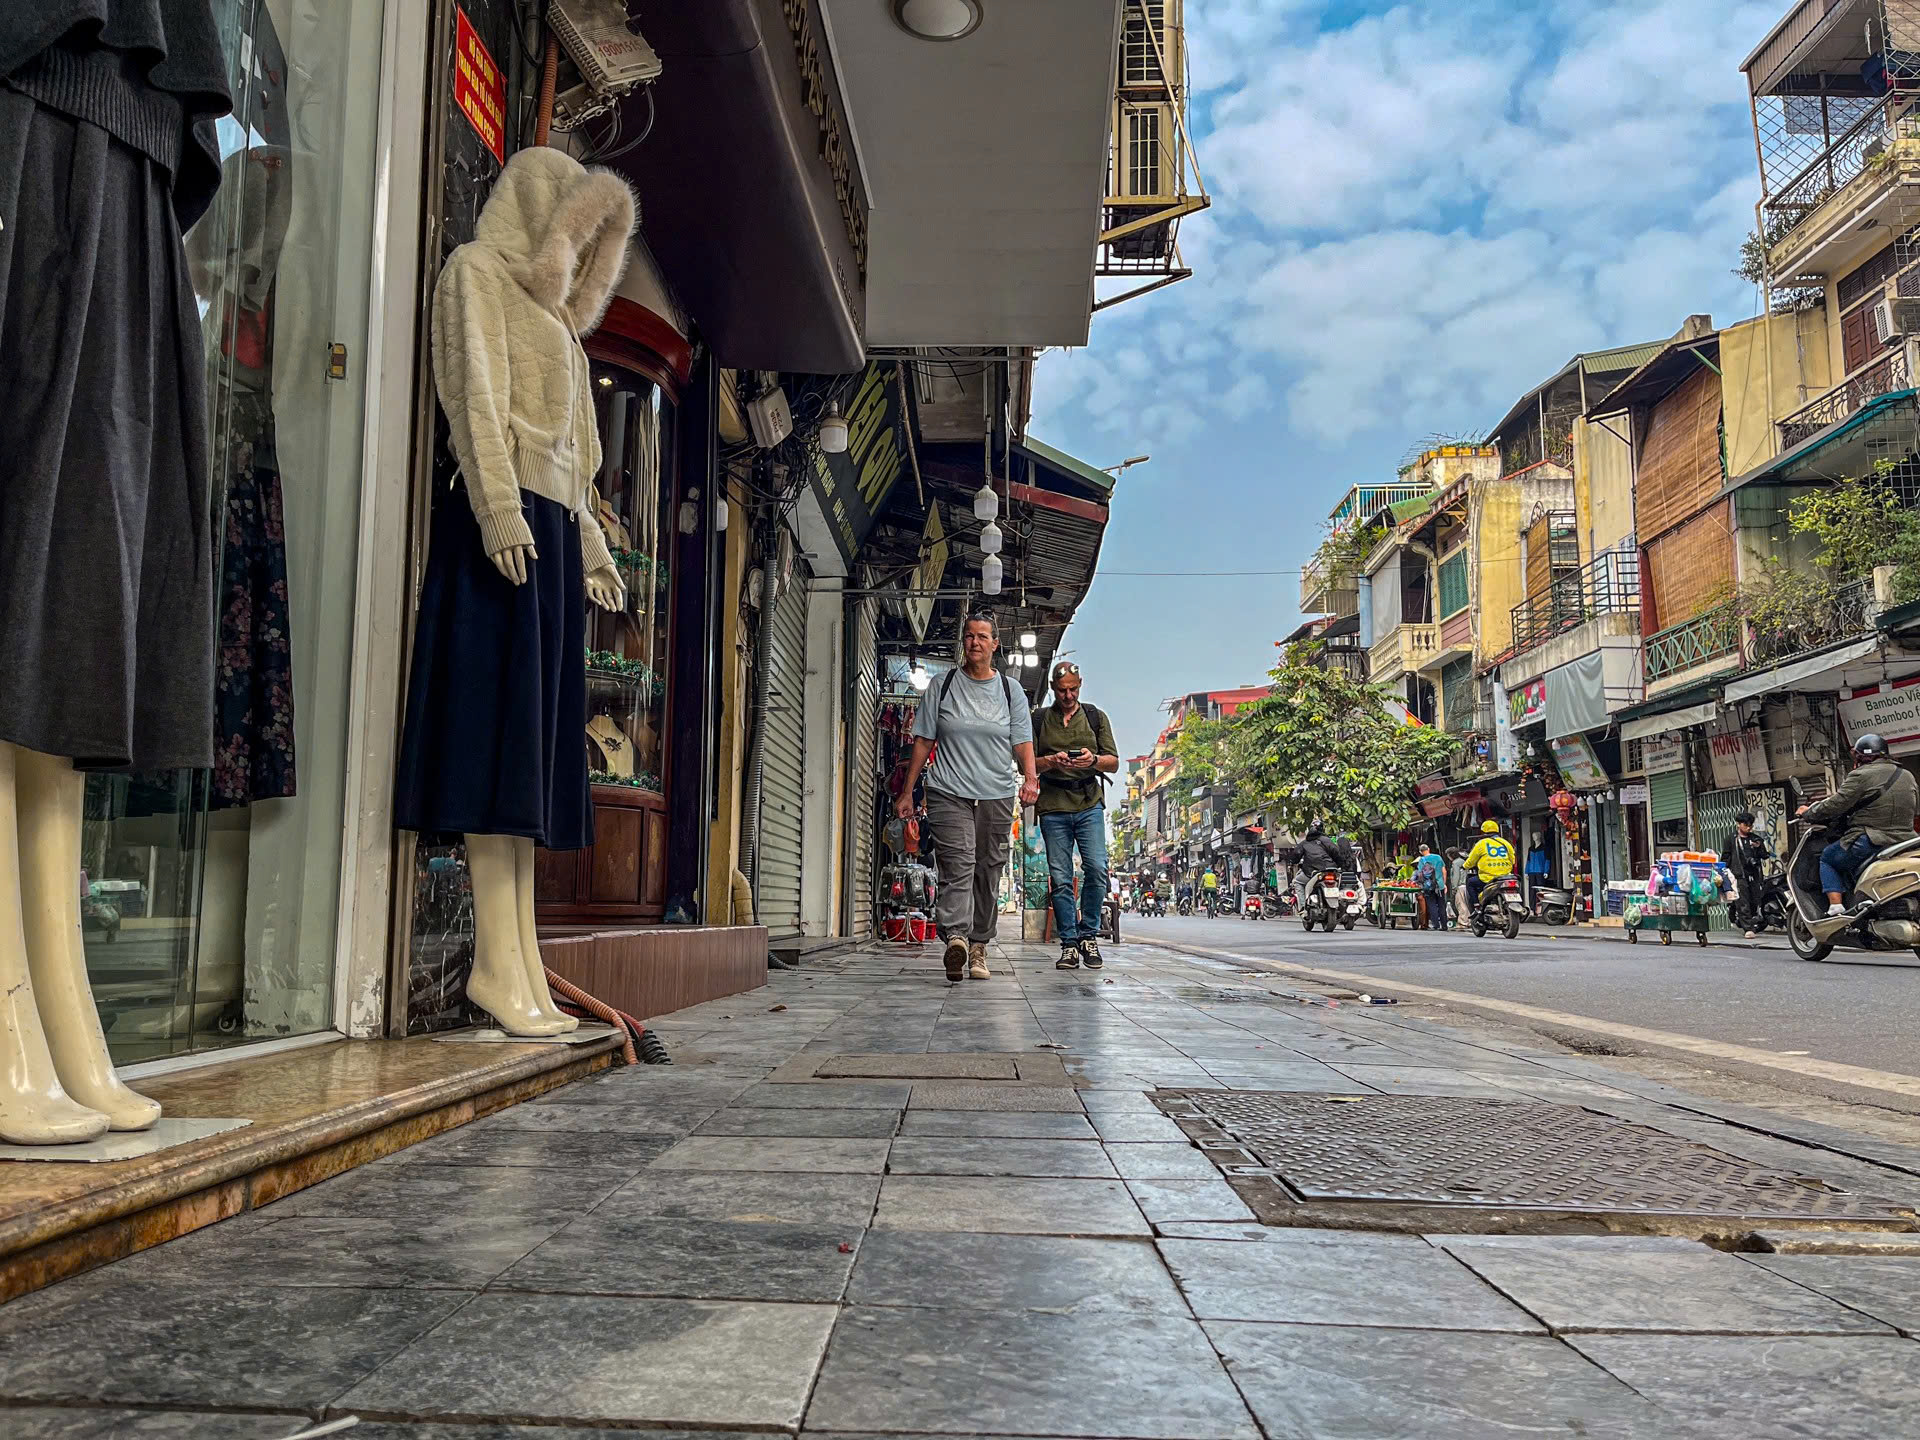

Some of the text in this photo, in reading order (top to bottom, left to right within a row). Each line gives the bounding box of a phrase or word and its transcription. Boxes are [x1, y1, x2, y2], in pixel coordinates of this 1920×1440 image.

[598, 39, 643, 58] 19001515
[483, 118, 496, 148] PCCC
[1865, 695, 1905, 711] Bamboo
[1486, 842, 1507, 857] be
